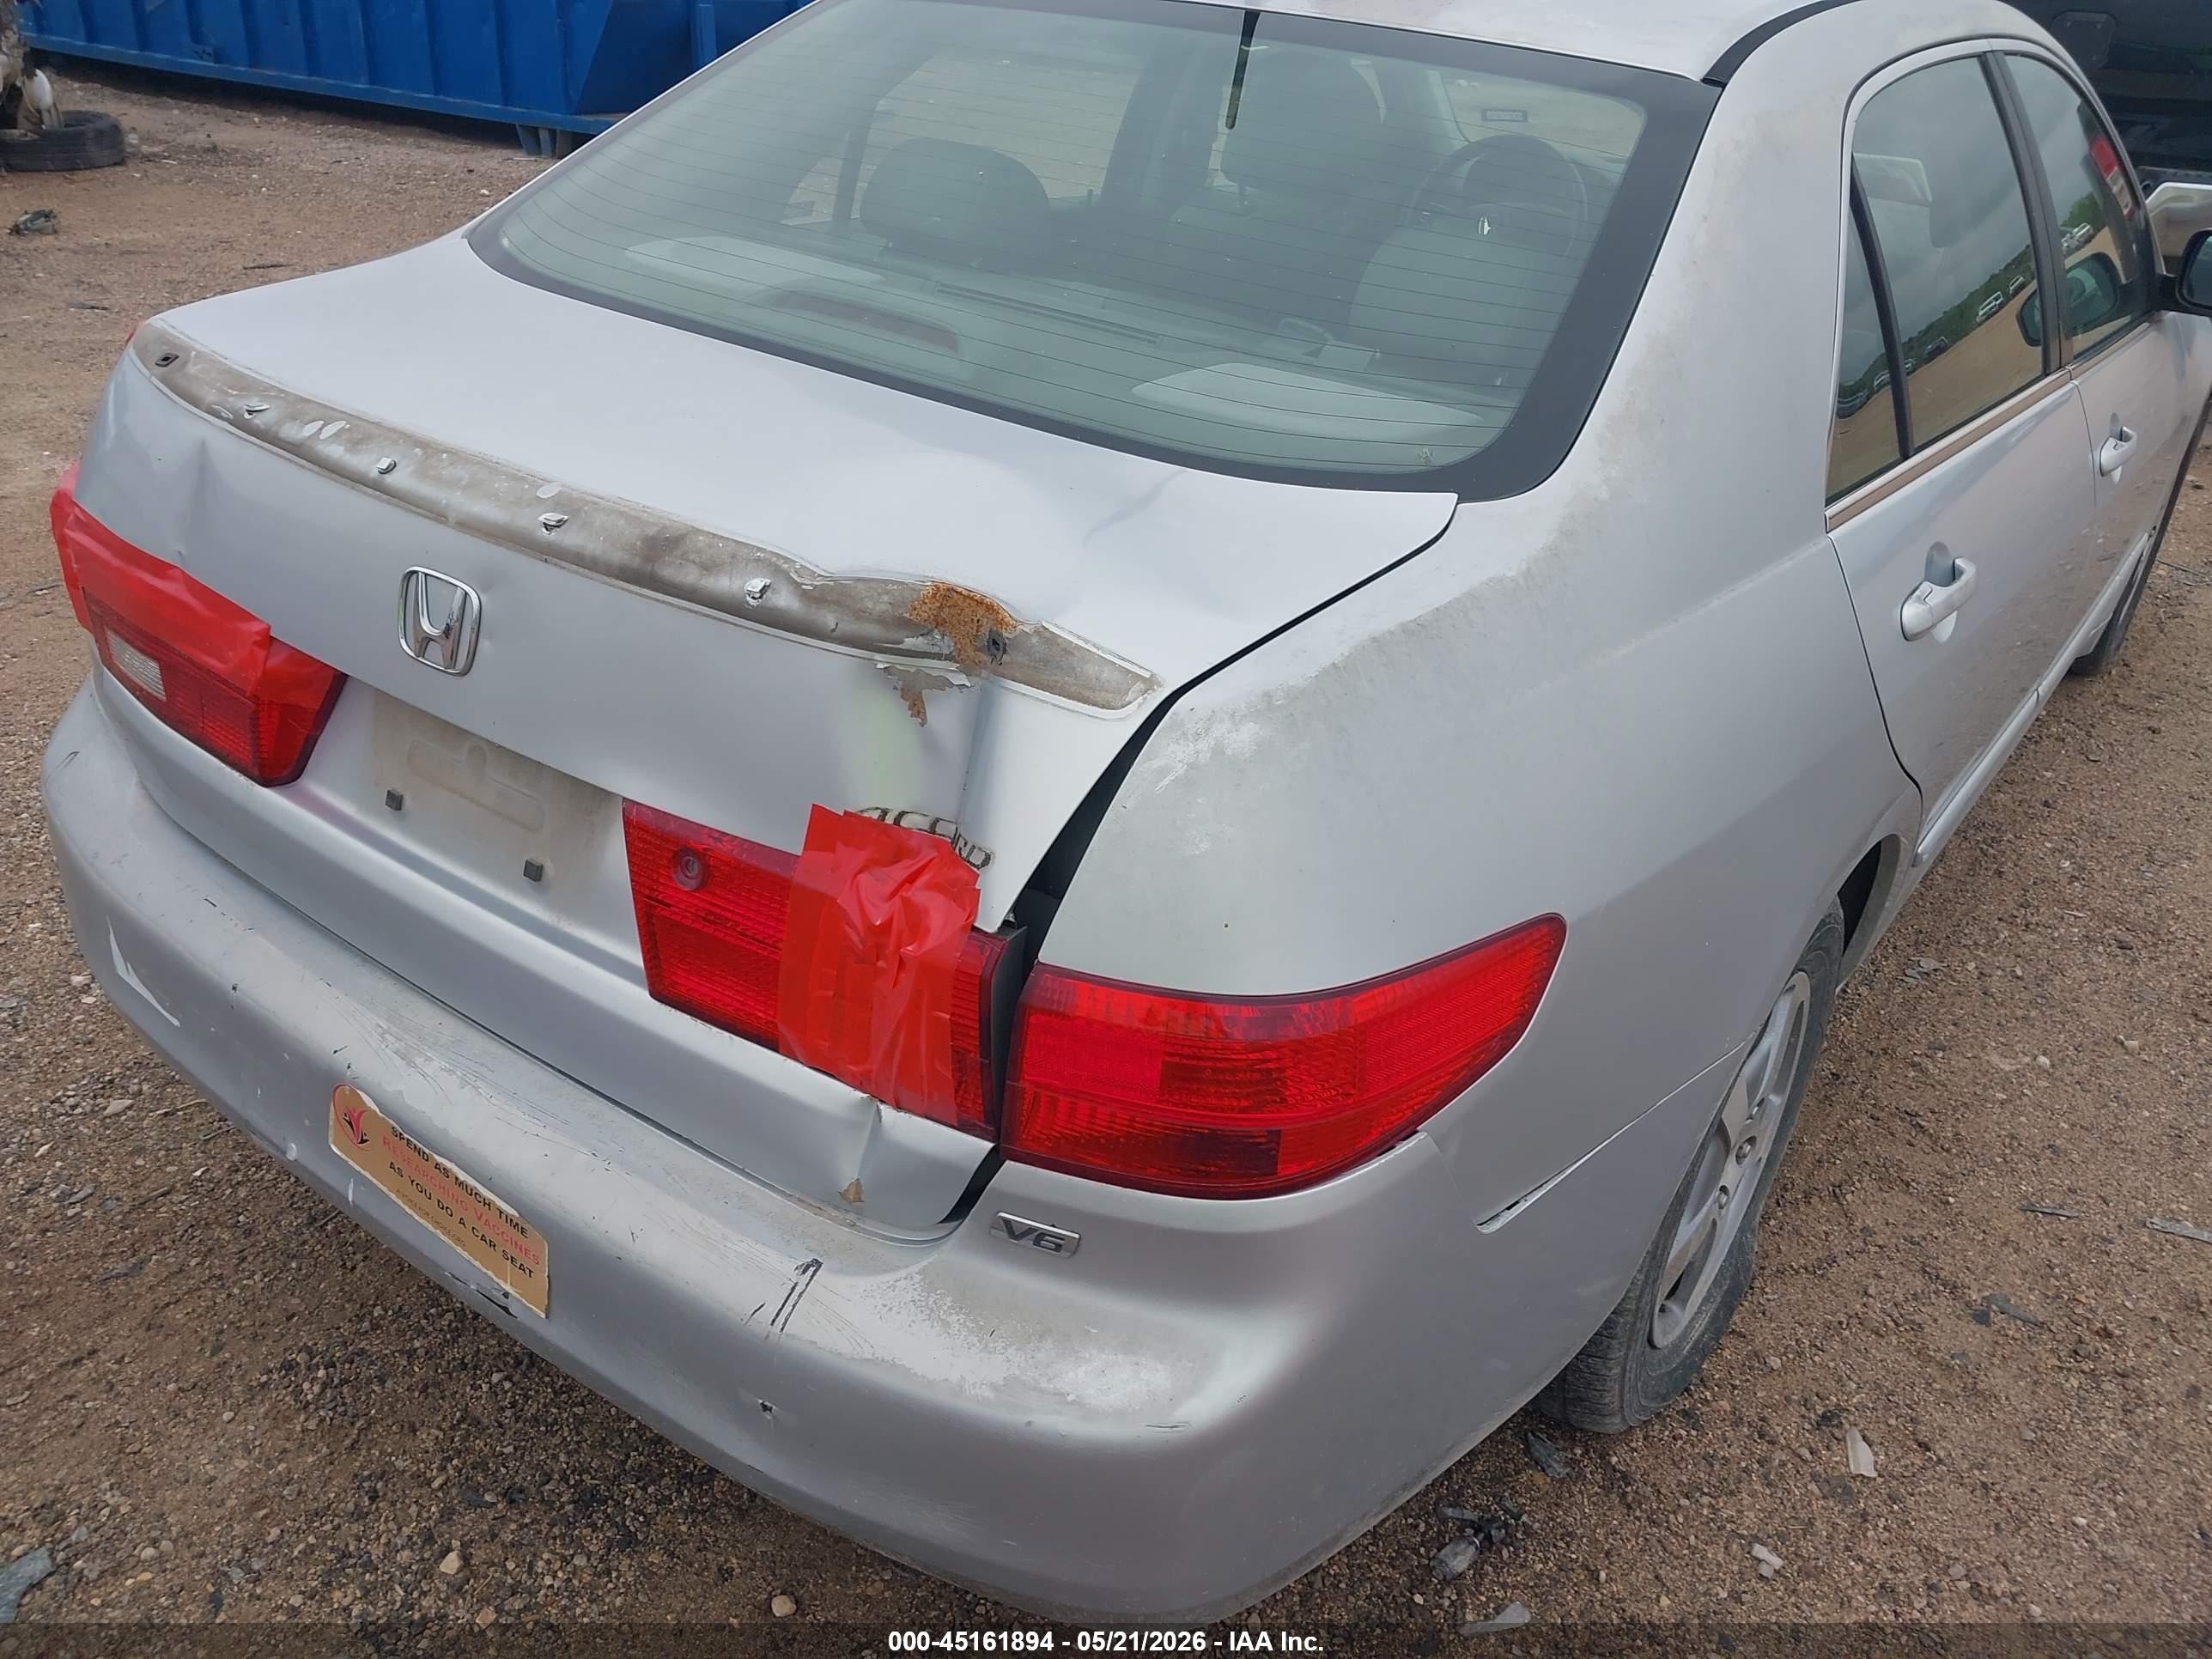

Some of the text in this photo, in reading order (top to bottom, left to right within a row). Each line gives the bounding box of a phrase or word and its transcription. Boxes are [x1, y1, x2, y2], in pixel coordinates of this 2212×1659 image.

[389, 1161, 535, 1279] AS YOU DO A CAR SEAT
[392, 1126, 529, 1240] SPEND AS MUCH TIME
[474, 1206, 540, 1266] VACCINES
[1001, 1218, 1066, 1254] V6
